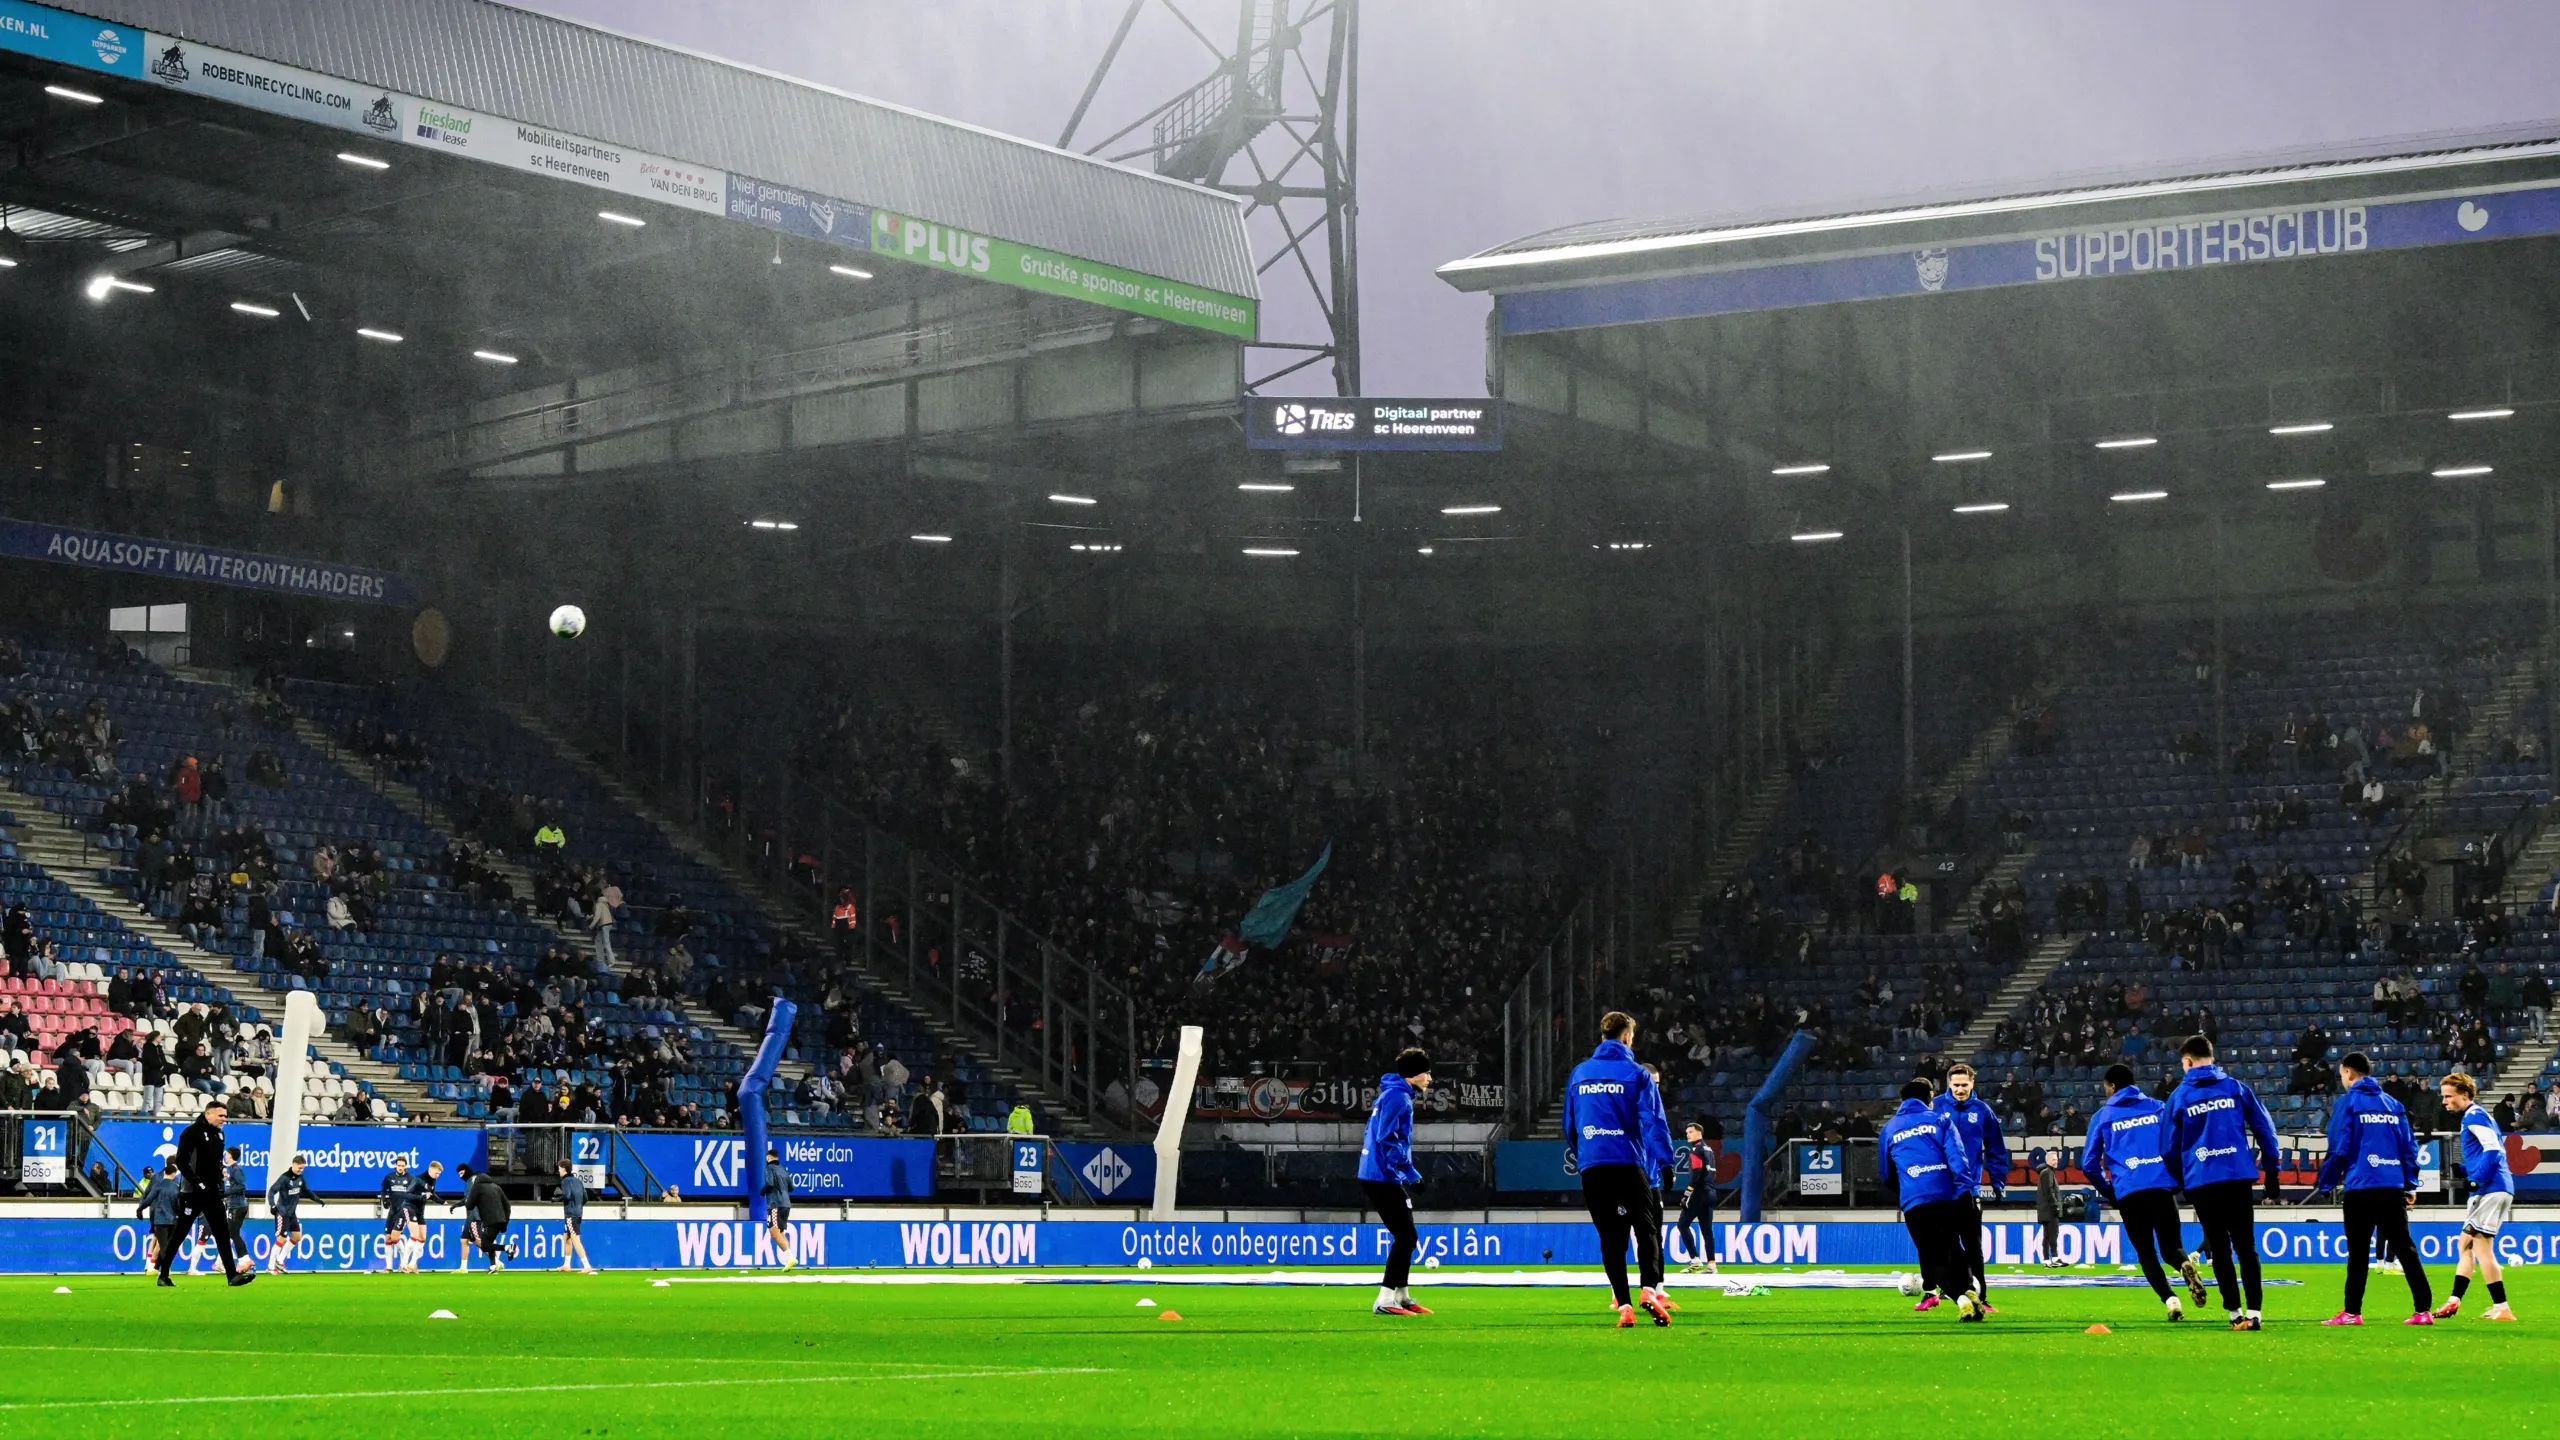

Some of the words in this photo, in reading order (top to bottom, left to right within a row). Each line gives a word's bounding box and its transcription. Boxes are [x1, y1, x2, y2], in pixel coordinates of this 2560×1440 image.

[91, 39, 127, 54] TOPPARKEN
[202, 62, 351, 111] ROBBENRECYCLING.COM
[418, 106, 472, 134] friesland
[442, 131, 467, 147] lease
[516, 125, 621, 165] Mobiliteitspartners
[531, 154, 542, 168] sc
[545, 155, 610, 184] Heerenveen
[650, 177, 670, 192] VAN
[671, 182, 691, 197] DEN
[693, 187, 718, 204] BRUG
[732, 175, 756, 197] Niet
[758, 185, 808, 212] genoten,
[731, 197, 758, 219] altijd
[761, 206, 782, 223] mis
[904, 222, 991, 273] PLUS
[2035, 206, 2368, 281] SUPPORTERSCLUB
[1020, 254, 1078, 286] Grutske
[1082, 272, 1141, 301] sponsor
[1144, 287, 1160, 305] sc
[1163, 287, 1247, 326] Heerenveen
[1374, 407, 1428, 421] Digitaal
[1430, 409, 1482, 421] partner
[1374, 425, 1390, 435] sc
[1393, 423, 1475, 435] Heerenveen
[47, 533, 169, 570] AQUASOFT
[175, 550, 384, 599] WATERONTHARDERS
[1938, 861, 1955, 872] 42
[1460, 1083, 1503, 1098] VAK-T
[1579, 1083, 1625, 1095] macron
[1460, 1096, 1504, 1107] GENERATIE
[2187, 1098, 2235, 1117] macron
[2112, 1114, 2159, 1132] macron
[2360, 1113, 2400, 1125] macron
[33, 1125, 56, 1151] 21
[1893, 1124, 1937, 1143] macron
[578, 1137, 600, 1160] 22
[785, 1140, 824, 1162] Méér
[826, 1142, 854, 1163] dan
[1019, 1146, 1037, 1167] 23
[1808, 1149, 1834, 1170] 25
[1090, 1164, 1124, 1178] VDK
[676, 1222, 825, 1267] WOLKOM
[901, 1222, 1036, 1265] WOLKOM
[1122, 1226, 1202, 1256] Ontdek
[1212, 1226, 1357, 1264] onbegrensd
[1376, 1227, 1500, 1264] Fyslân
[1982, 1224, 2121, 1265] OLKOM
